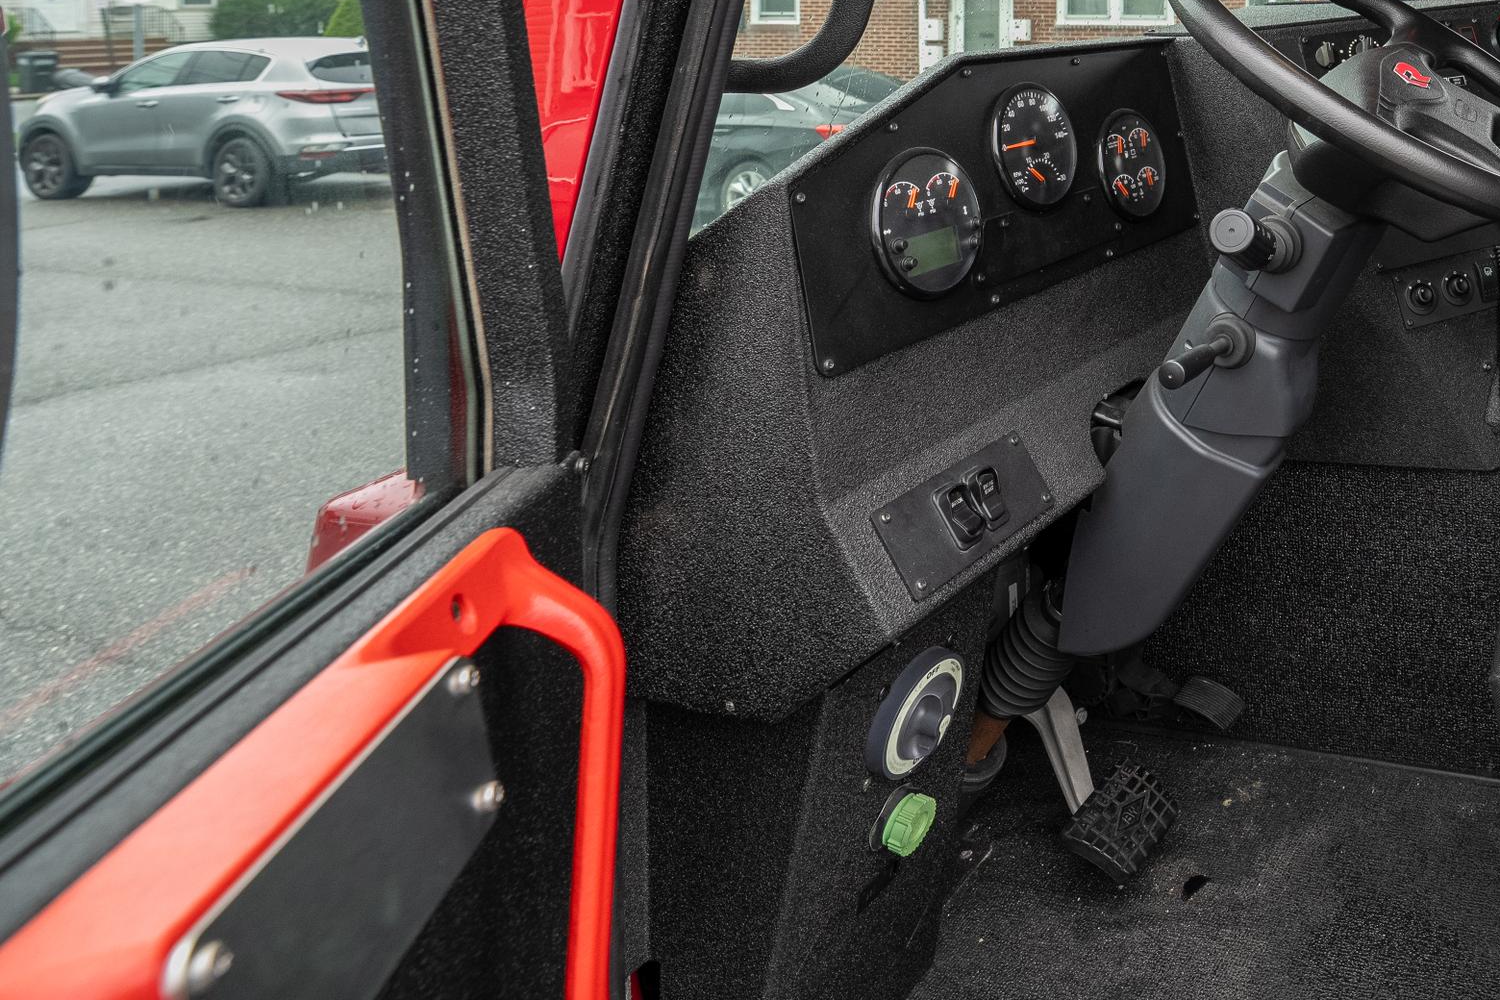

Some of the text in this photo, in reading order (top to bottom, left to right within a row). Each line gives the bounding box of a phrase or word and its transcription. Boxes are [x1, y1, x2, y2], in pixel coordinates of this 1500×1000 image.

[1047, 114, 1057, 122] 120
[1004, 124, 1011, 132] 20
[926, 666, 941, 680] OFF
